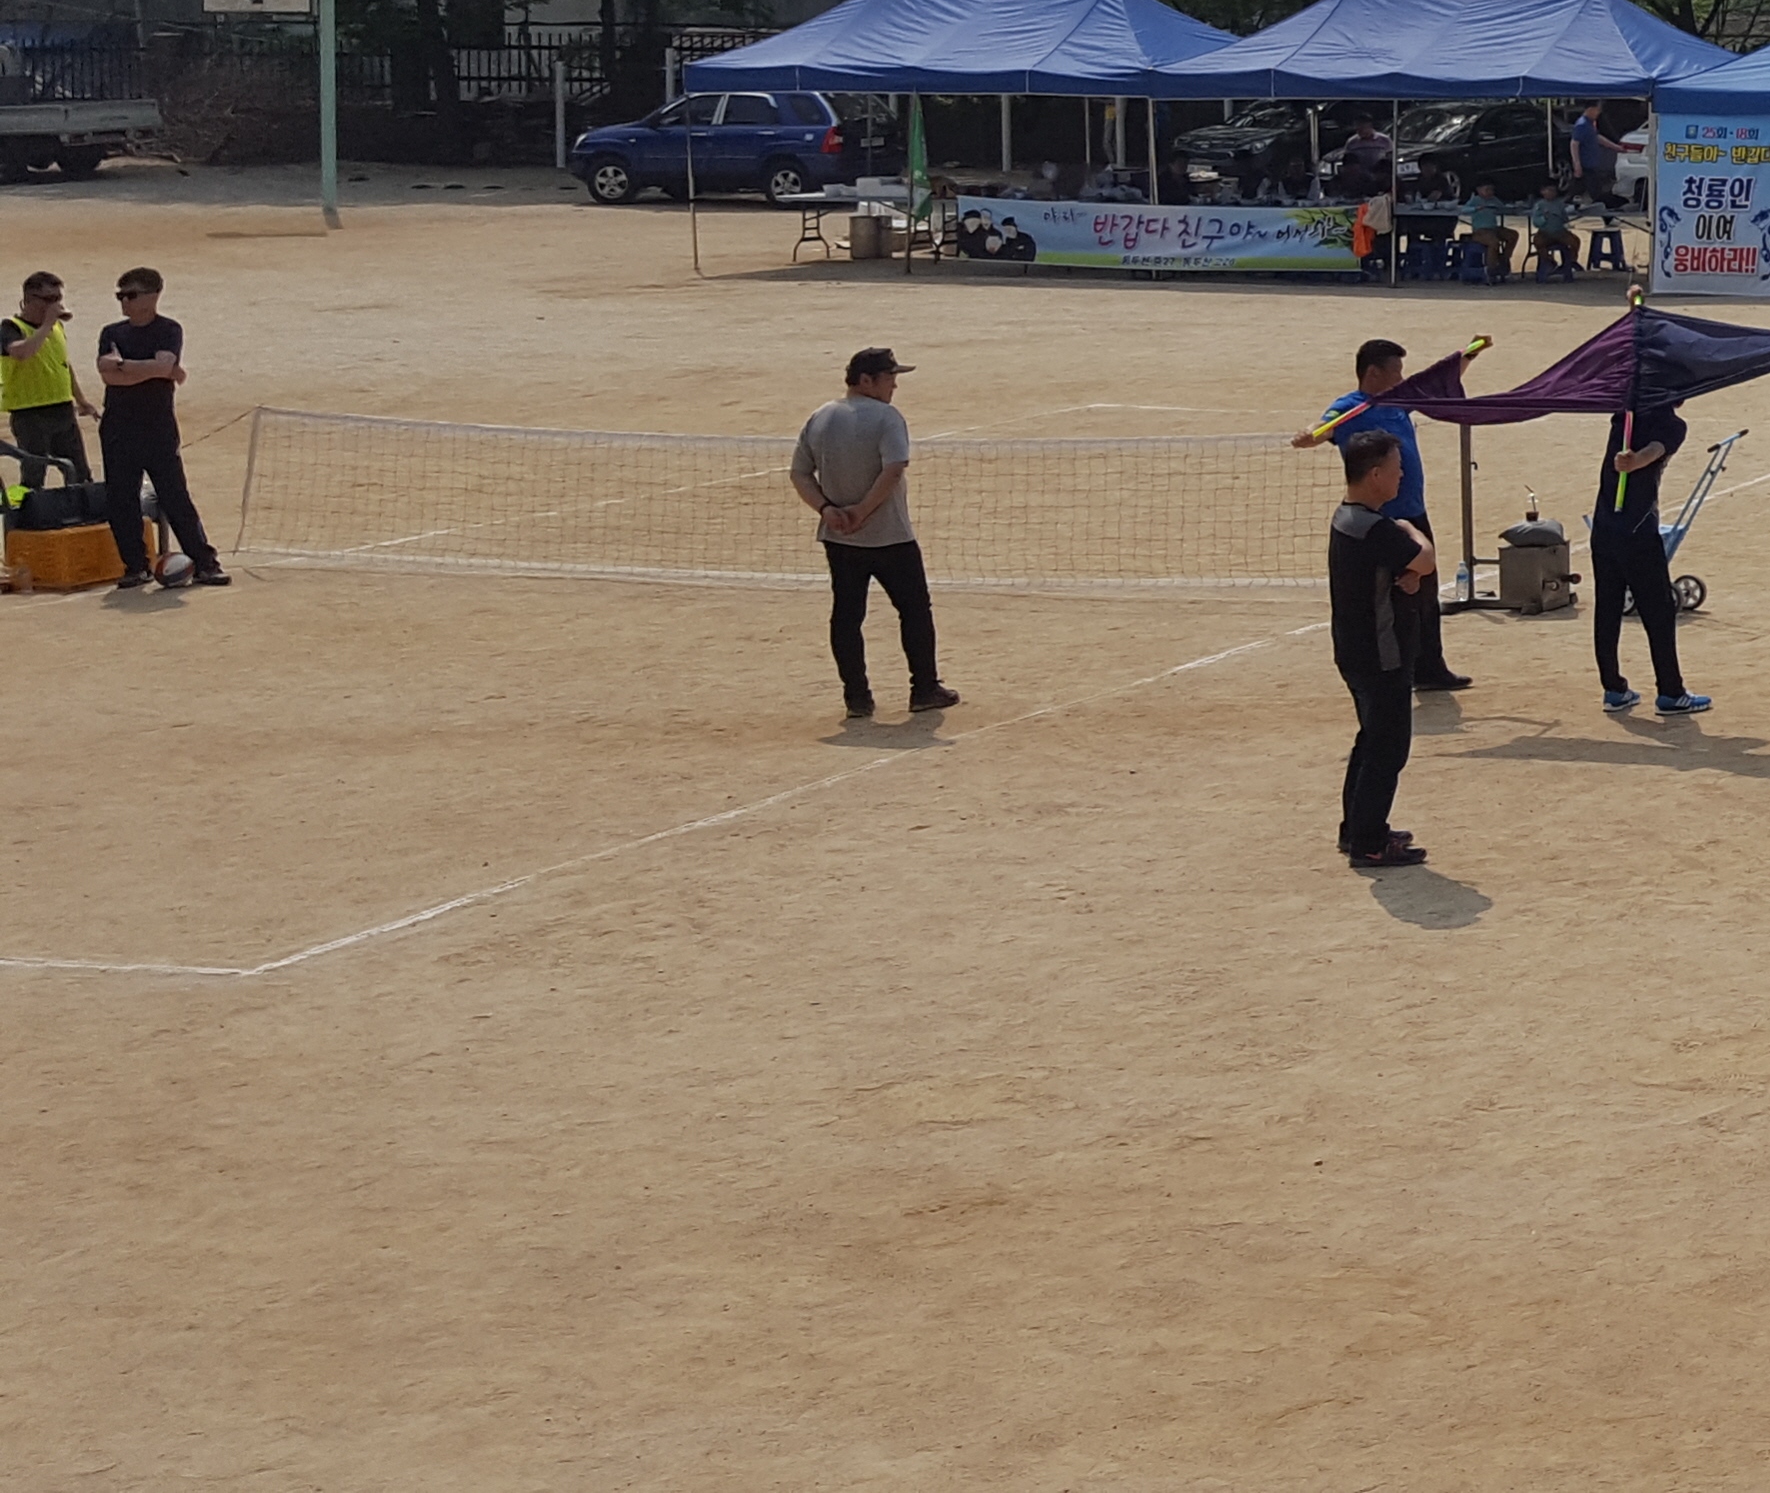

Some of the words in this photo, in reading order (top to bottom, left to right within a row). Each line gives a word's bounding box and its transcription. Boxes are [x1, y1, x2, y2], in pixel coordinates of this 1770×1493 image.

[1682, 175, 1754, 210] 청룡인
[1093, 213, 1170, 250] 반갑다
[1695, 213, 1735, 241] 이여
[1673, 245, 1758, 274] 웅비하라!!
